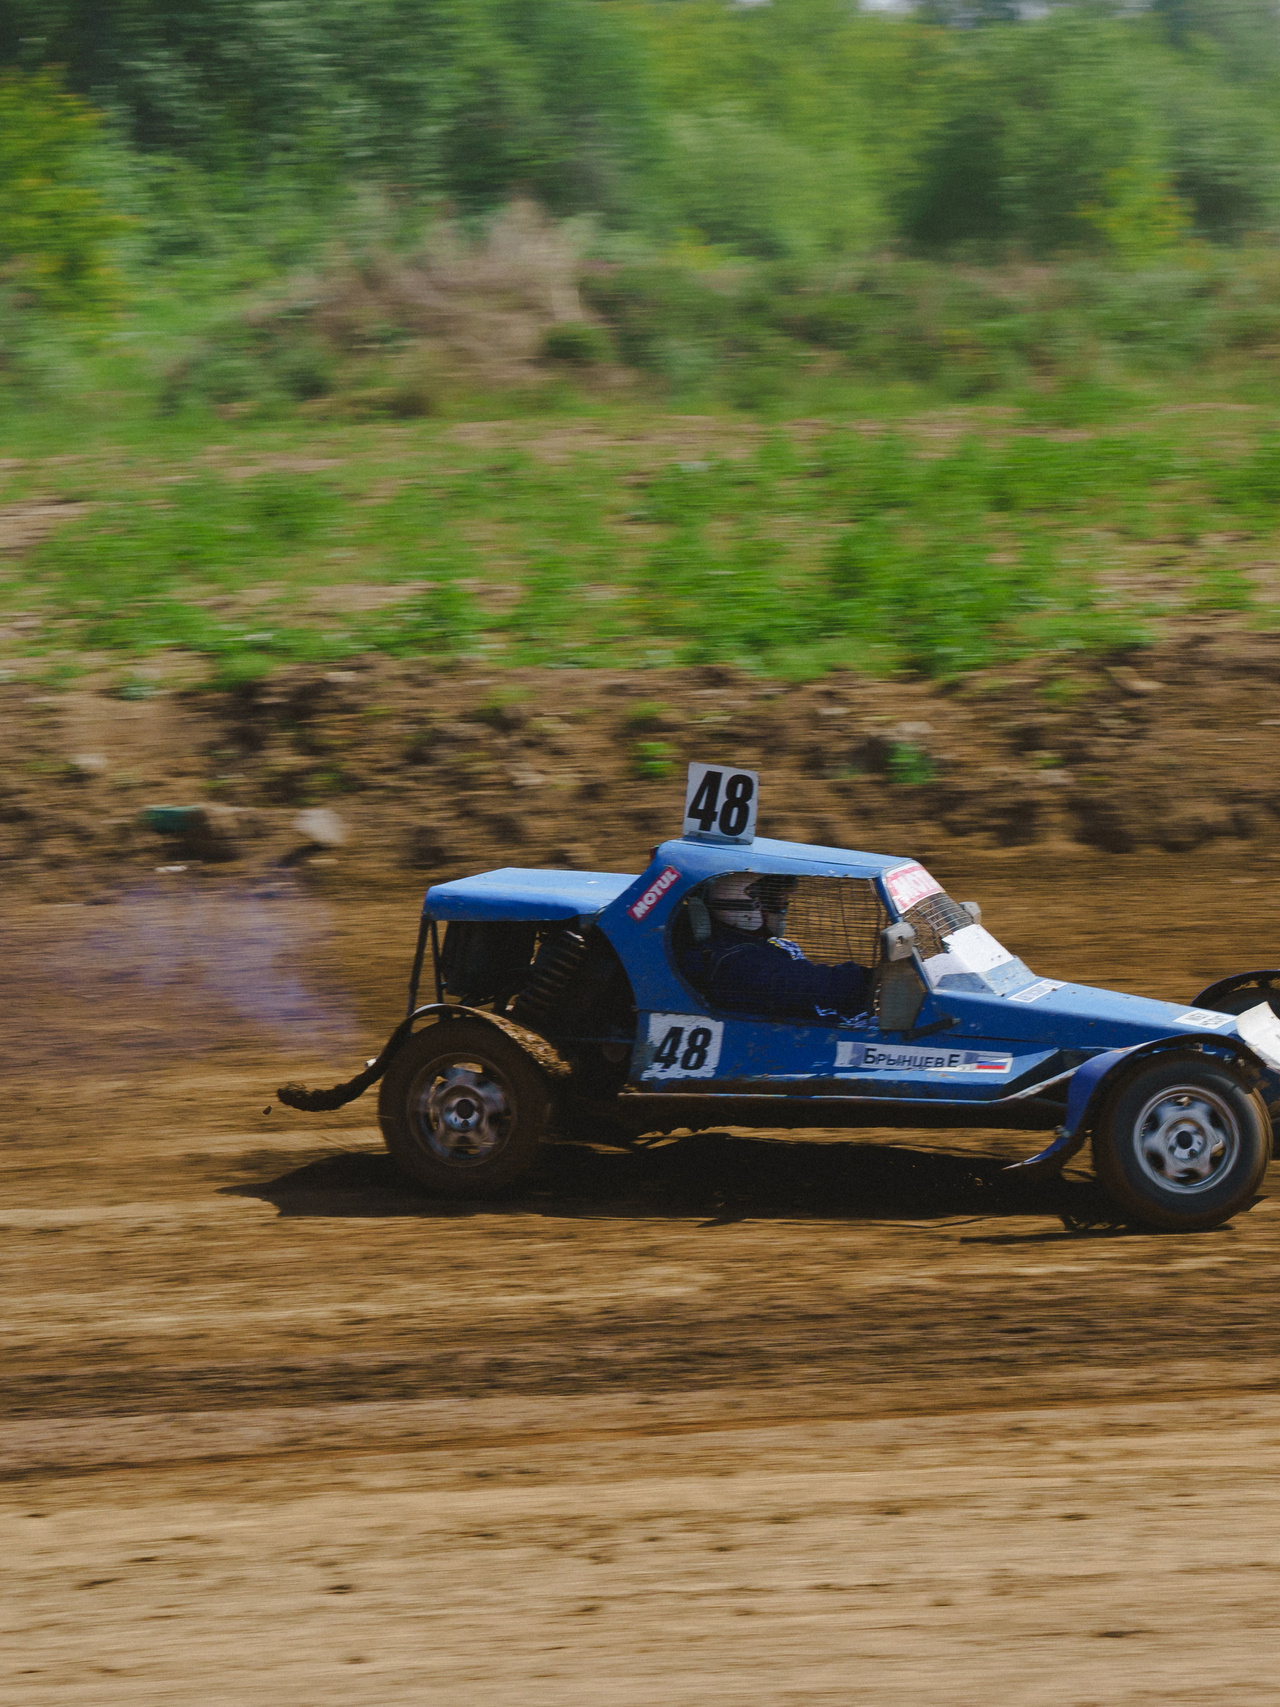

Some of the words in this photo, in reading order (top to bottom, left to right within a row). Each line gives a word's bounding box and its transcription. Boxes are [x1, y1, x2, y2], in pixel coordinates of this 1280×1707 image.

[687, 770, 754, 836] 48
[632, 871, 678, 919] MOTUL
[653, 1027, 712, 1071] 48
